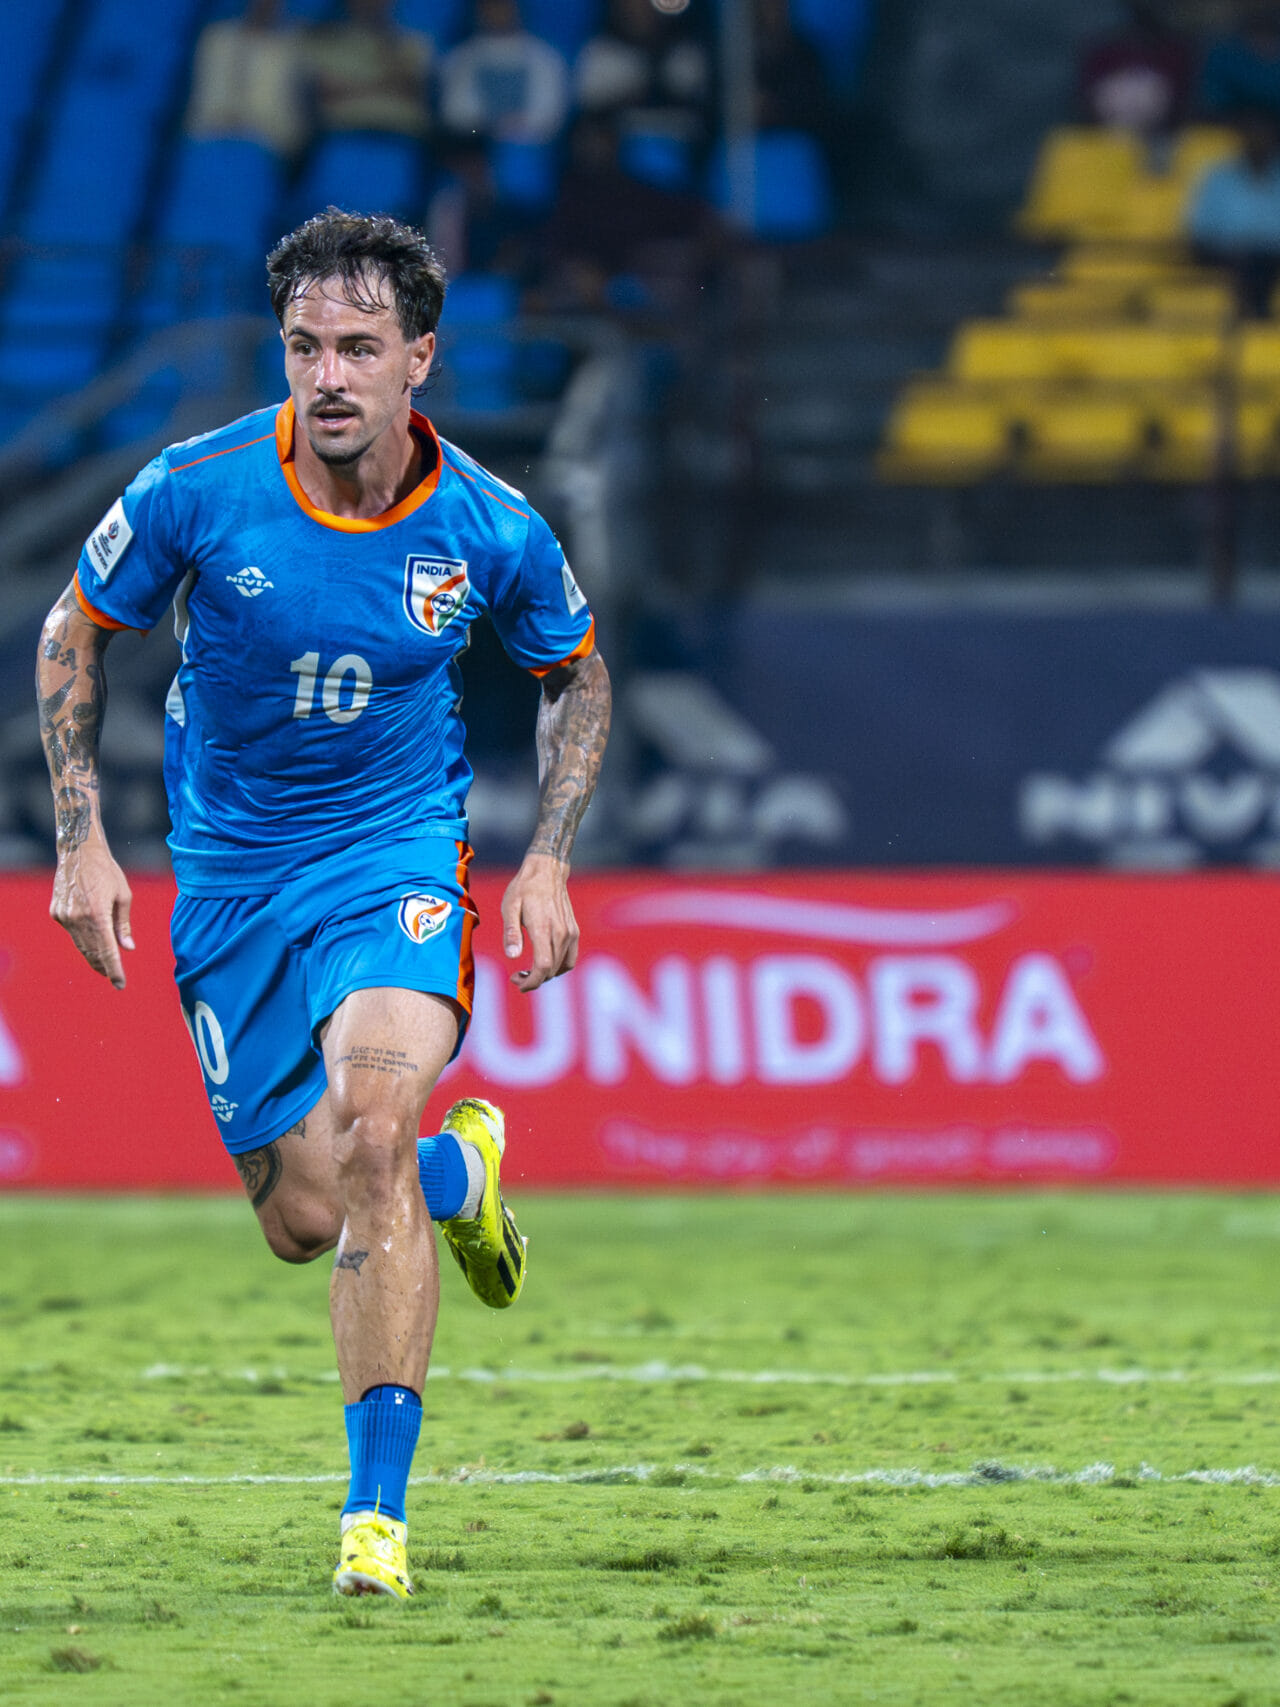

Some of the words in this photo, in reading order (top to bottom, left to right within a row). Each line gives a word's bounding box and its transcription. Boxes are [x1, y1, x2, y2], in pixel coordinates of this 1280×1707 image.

[416, 564, 452, 577] INDIA
[225, 575, 275, 589] NIVIA
[290, 651, 373, 724] 10
